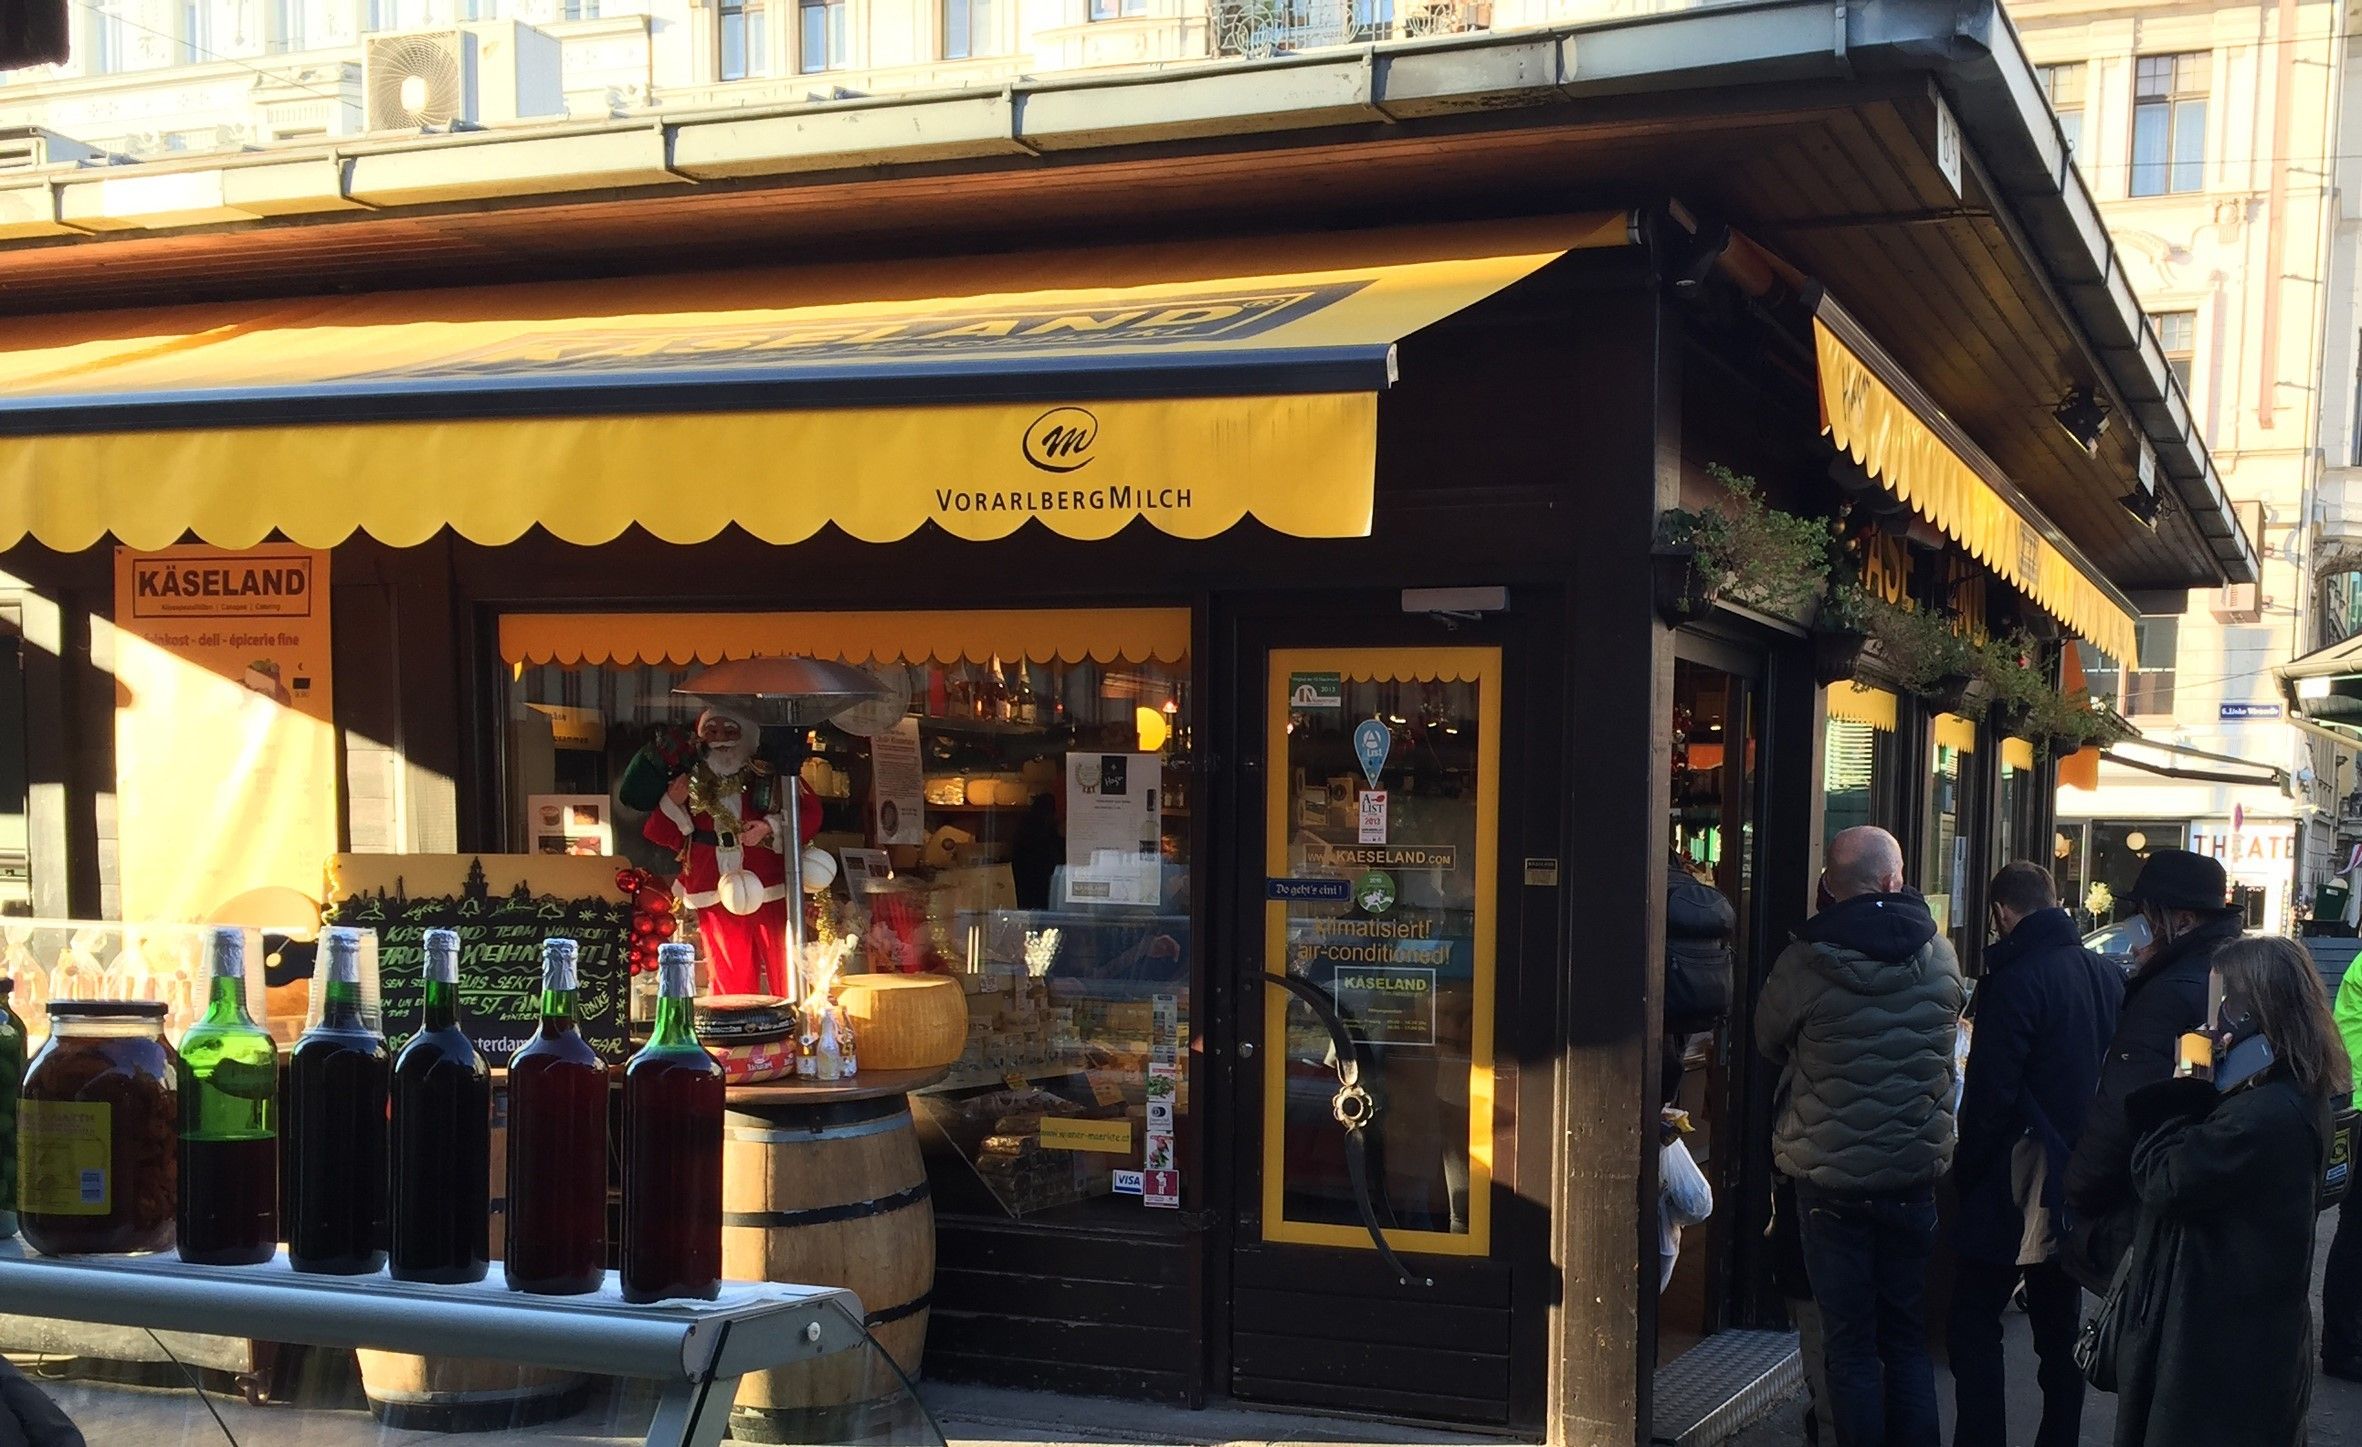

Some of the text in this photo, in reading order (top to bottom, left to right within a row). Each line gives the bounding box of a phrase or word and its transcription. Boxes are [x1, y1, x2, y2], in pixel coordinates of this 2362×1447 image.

[138, 564, 306, 597] KÄSELAND
[1308, 850, 1451, 865] WW.KAESELAND.COM
[1314, 915, 1432, 940] klimatisiert!
[1298, 943, 1451, 966] air-conditioned!
[1344, 975, 1427, 991] KÄSELAND
[1118, 1174, 1141, 1186] VISA
